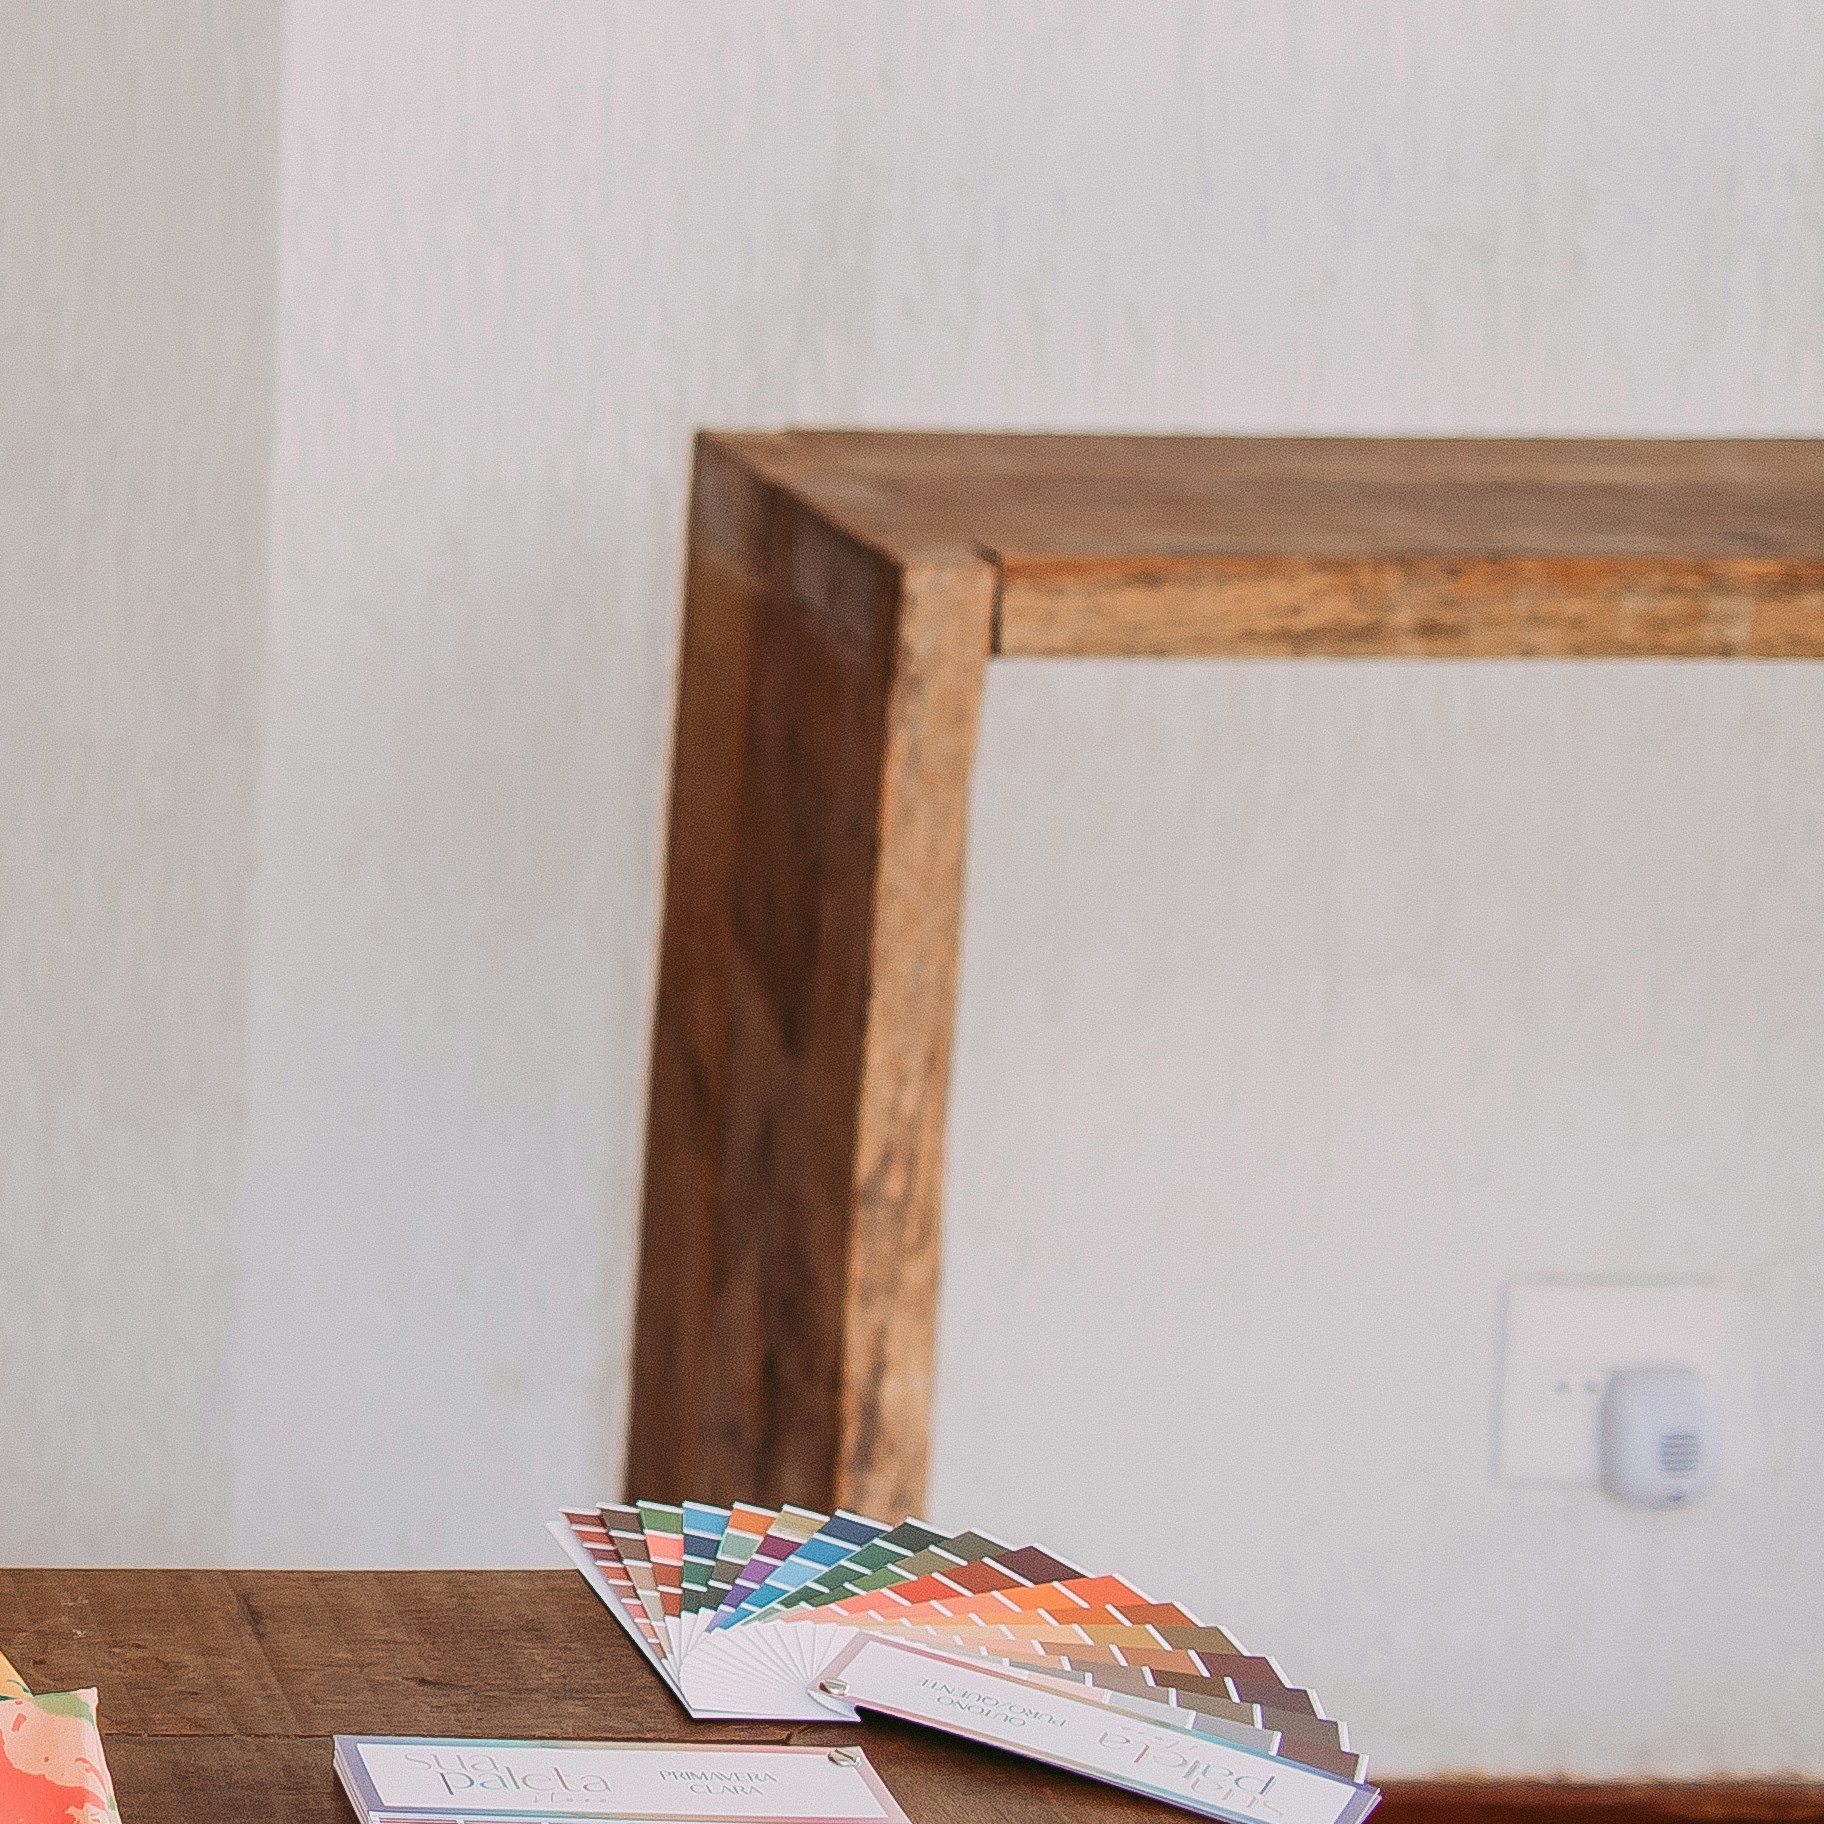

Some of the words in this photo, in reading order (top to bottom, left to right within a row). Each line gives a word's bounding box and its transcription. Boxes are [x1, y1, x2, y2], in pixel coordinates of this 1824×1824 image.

[936, 1696, 1027, 1727] OUTONO
[404, 1752, 500, 1772] sua
[438, 1766, 612, 1796] paleta
[658, 1770, 778, 1782] PRIMAVERA
[689, 1784, 764, 1795] CLARA
